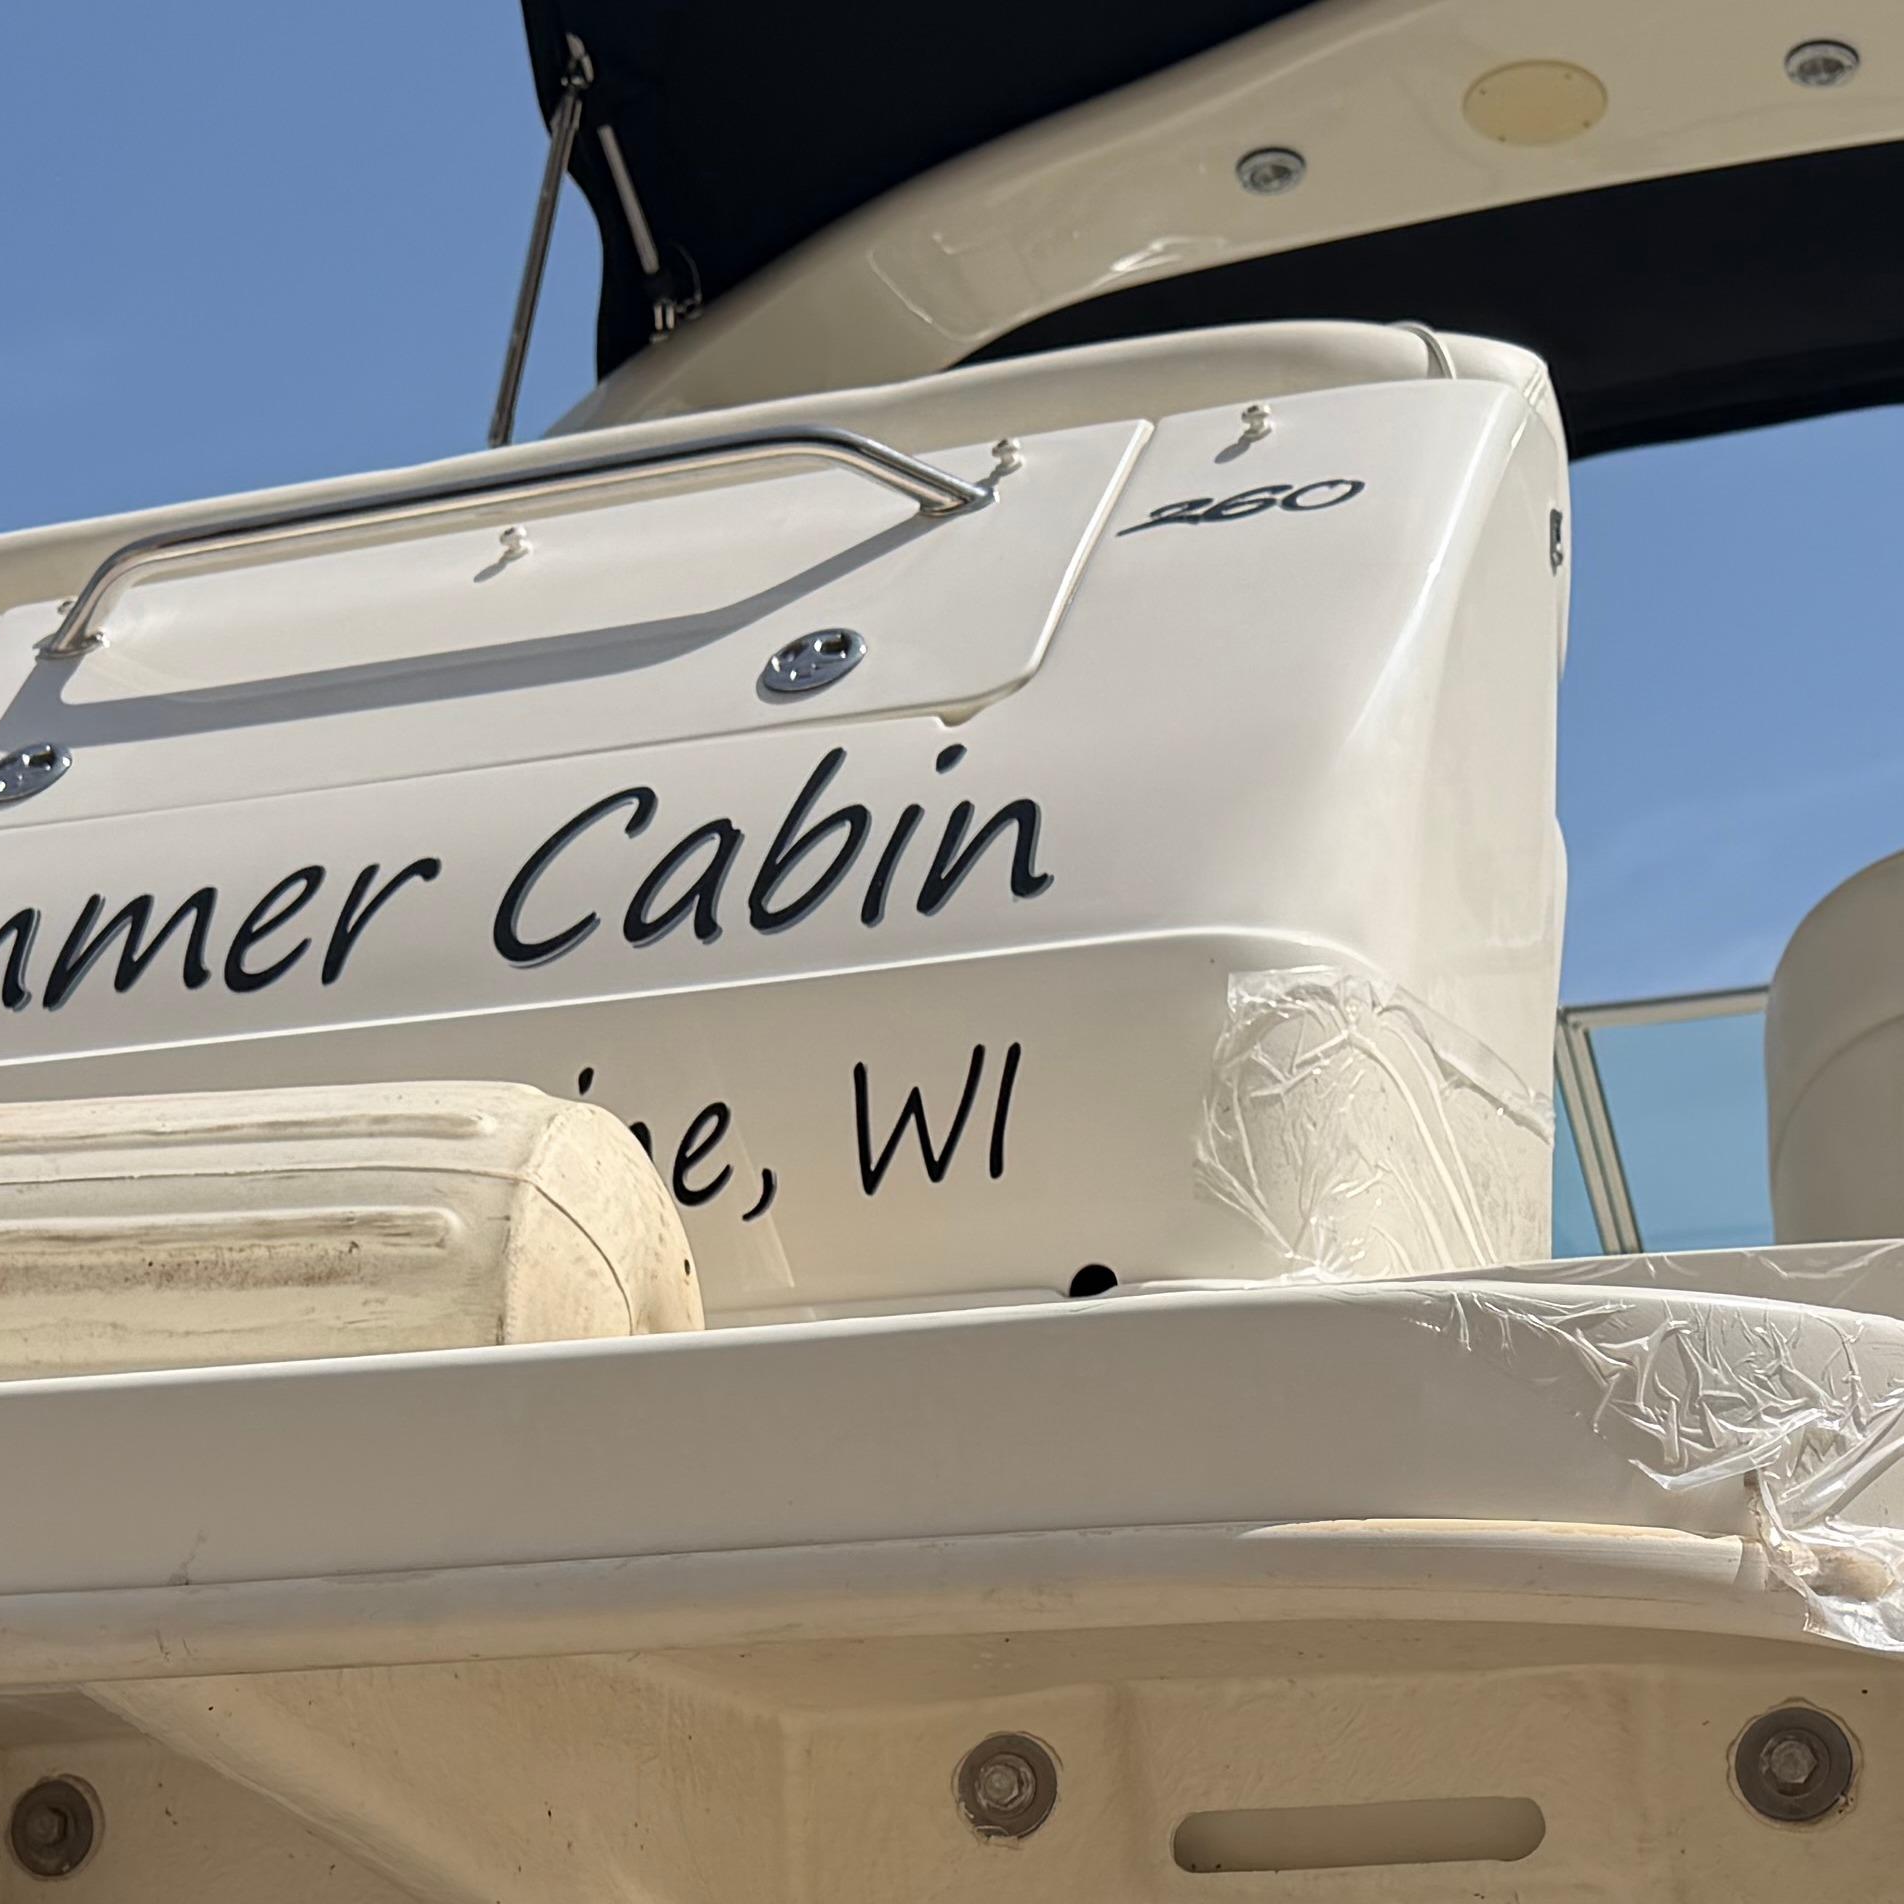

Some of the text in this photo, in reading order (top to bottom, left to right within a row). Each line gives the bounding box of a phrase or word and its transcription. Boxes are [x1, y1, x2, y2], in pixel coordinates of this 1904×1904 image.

[1115, 479, 1366, 537] 260
[492, 743, 1055, 970] Cabin
[853, 1041, 1022, 1196] WI
